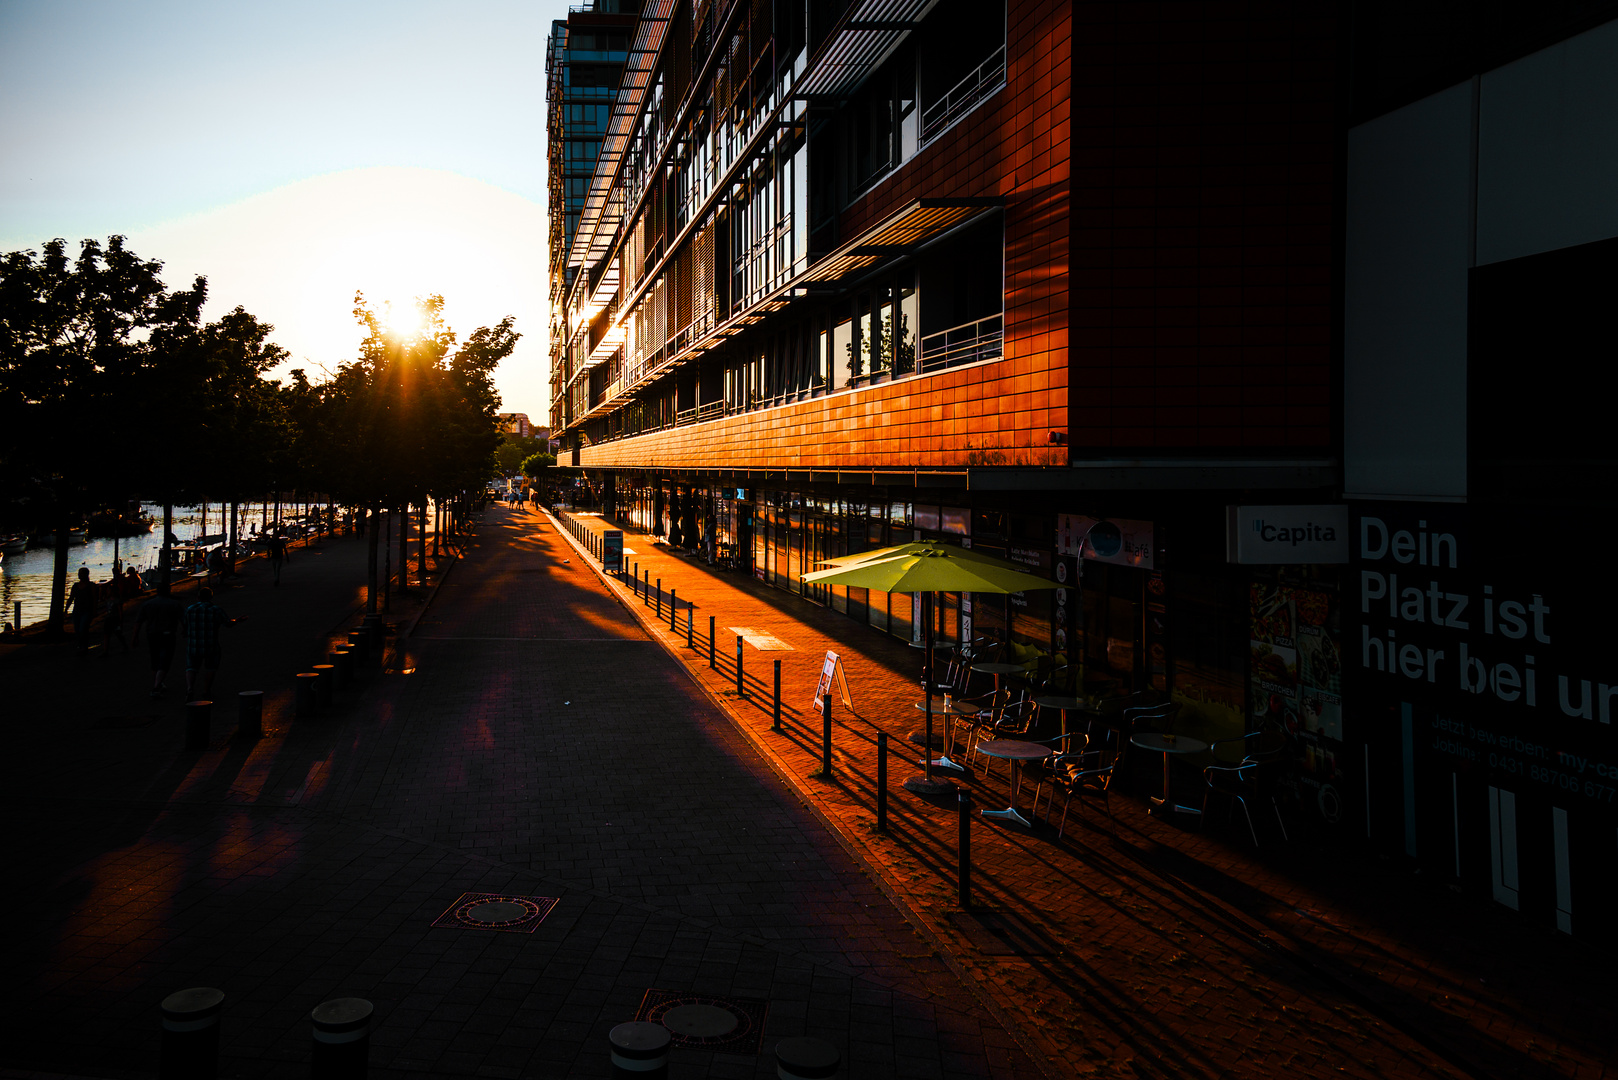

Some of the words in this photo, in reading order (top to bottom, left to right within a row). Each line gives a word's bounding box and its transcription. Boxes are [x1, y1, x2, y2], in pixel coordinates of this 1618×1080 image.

[1261, 522, 1336, 546] Capita
[1361, 516, 1457, 568] Dein
[1361, 570, 1470, 630] Platz
[1483, 585, 1551, 644] ist
[1361, 624, 1445, 683] hier
[1459, 641, 1536, 707] bei
[1432, 712, 1465, 736] Jetzt
[1469, 722, 1550, 760] bewerben:
[1488, 752, 1524, 776] 0431
[1530, 764, 1580, 792] 88706
[1584, 780, 1616, 803] 677
